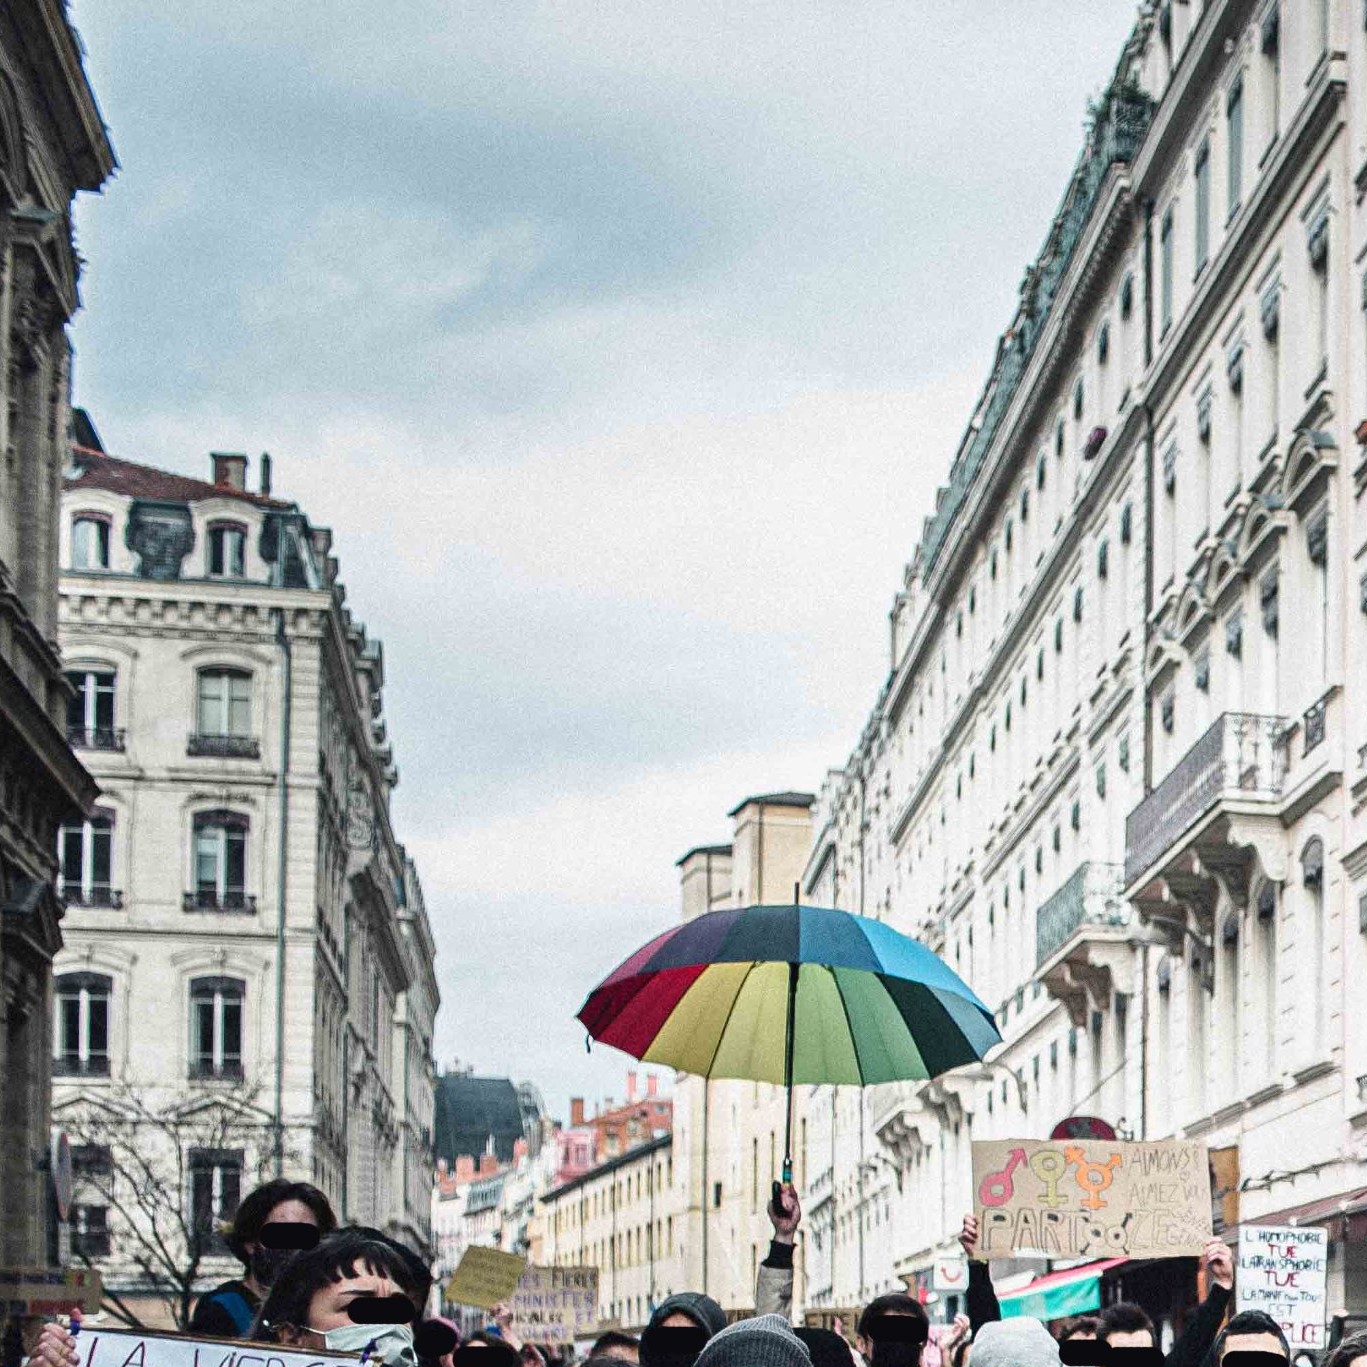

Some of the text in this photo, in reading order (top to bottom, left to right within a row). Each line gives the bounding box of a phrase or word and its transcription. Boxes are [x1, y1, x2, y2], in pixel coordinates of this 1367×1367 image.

[1268, 1243, 1297, 1258] TUE
[1264, 1270, 1299, 1288] TUE
[1281, 1321, 1320, 1344] PLICE
